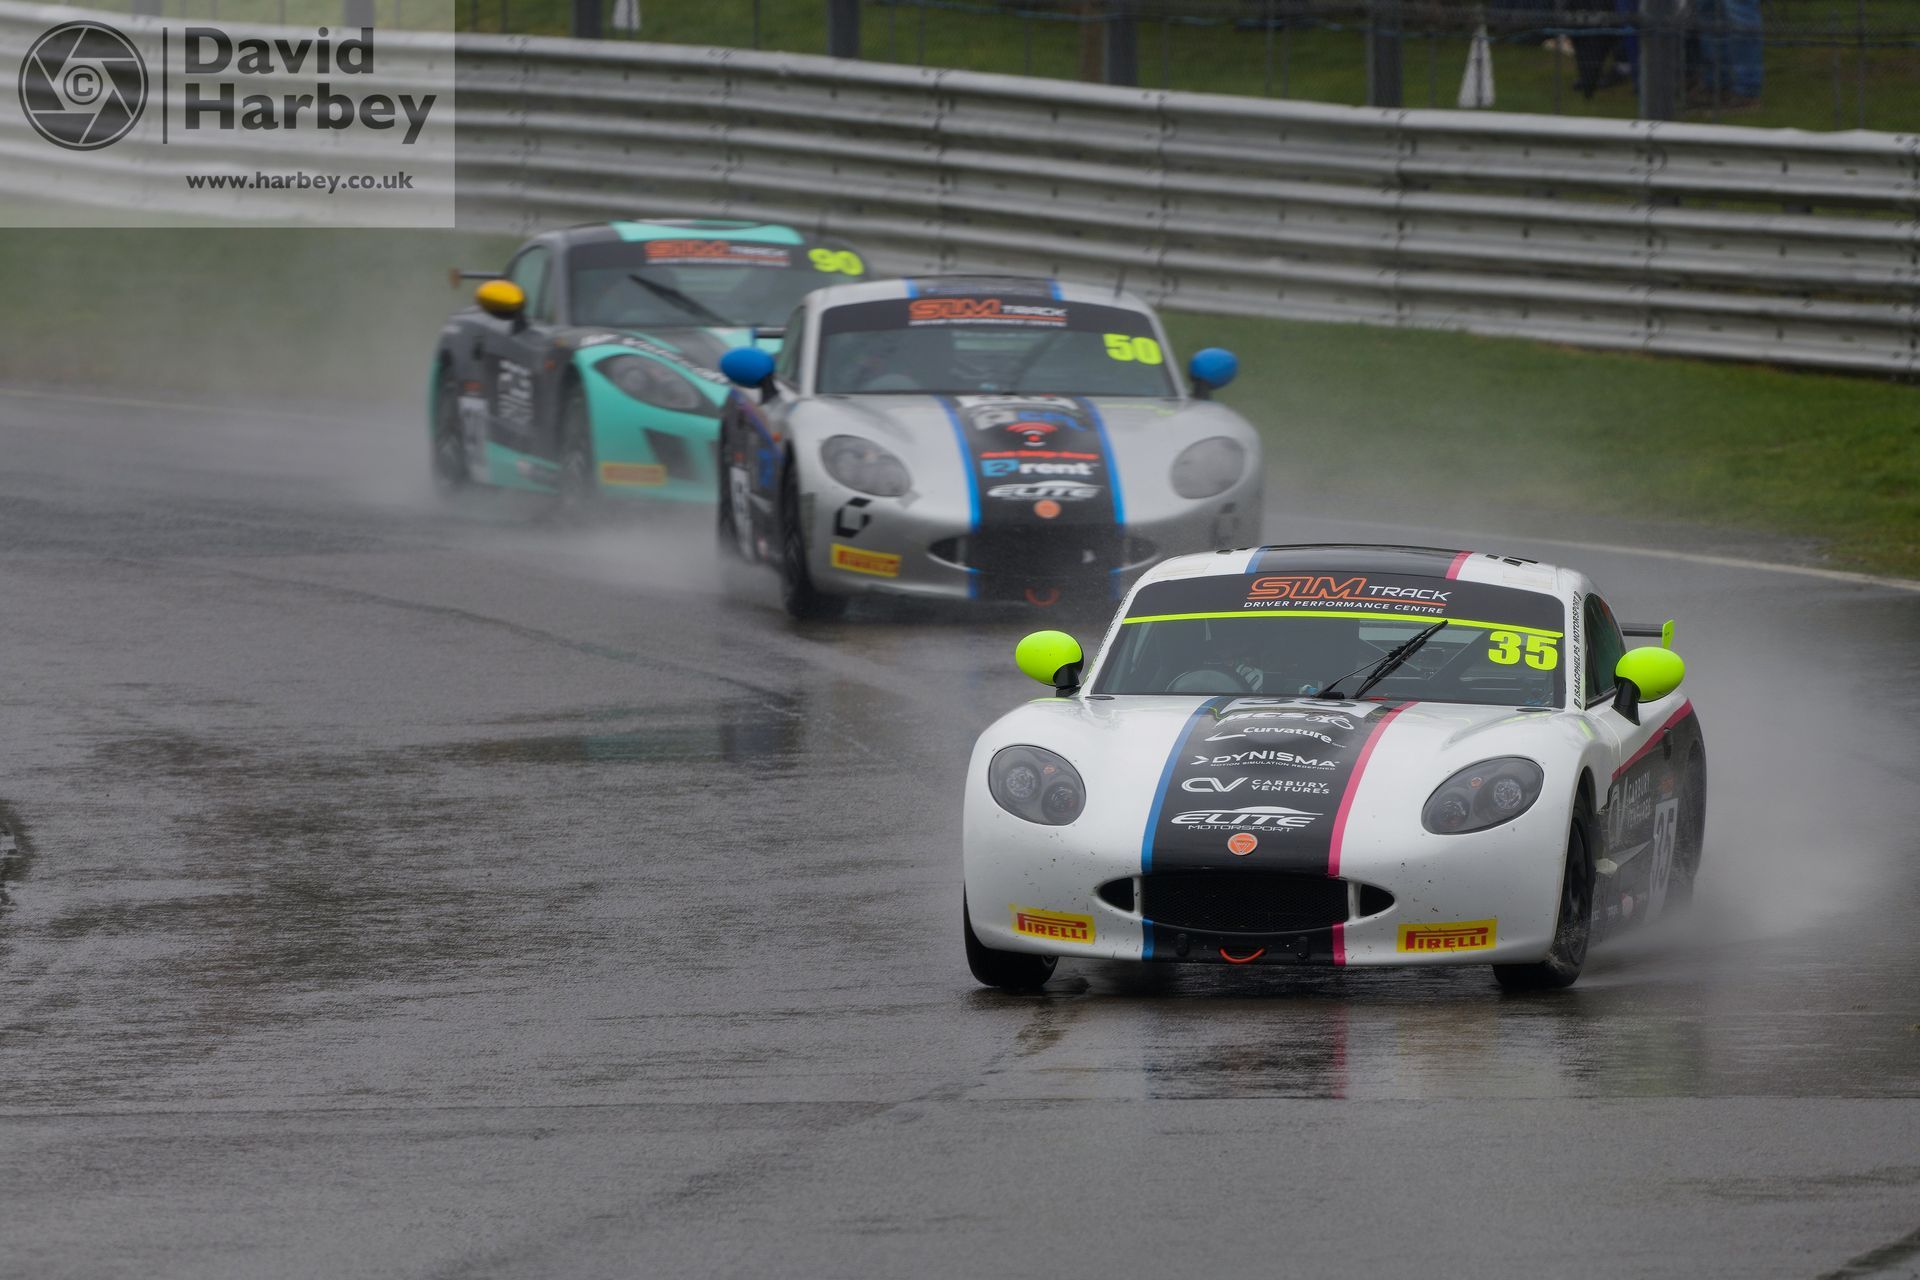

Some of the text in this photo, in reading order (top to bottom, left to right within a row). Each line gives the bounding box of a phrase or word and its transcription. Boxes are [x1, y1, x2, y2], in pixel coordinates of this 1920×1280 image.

[808, 248, 865, 276] 90
[909, 298, 1002, 319] SIM
[1103, 333, 1163, 365] 50
[1247, 576, 1453, 602] SIM TRACK
[1243, 600, 1445, 615] DRIVER PERFORMANCE CENTRE
[1487, 630, 1559, 671] 35
[1243, 726, 1333, 744] Curvature
[1212, 750, 1336, 767] DYNISMA
[1251, 779, 1329, 788] CARBURY
[1251, 784, 1331, 795] VENTURES
[1171, 812, 1317, 828] ELITE
[1187, 824, 1295, 833] MOTORSPORT
[1016, 911, 1089, 941] PIRELLI
[1405, 927, 1490, 951] PIRELLI
